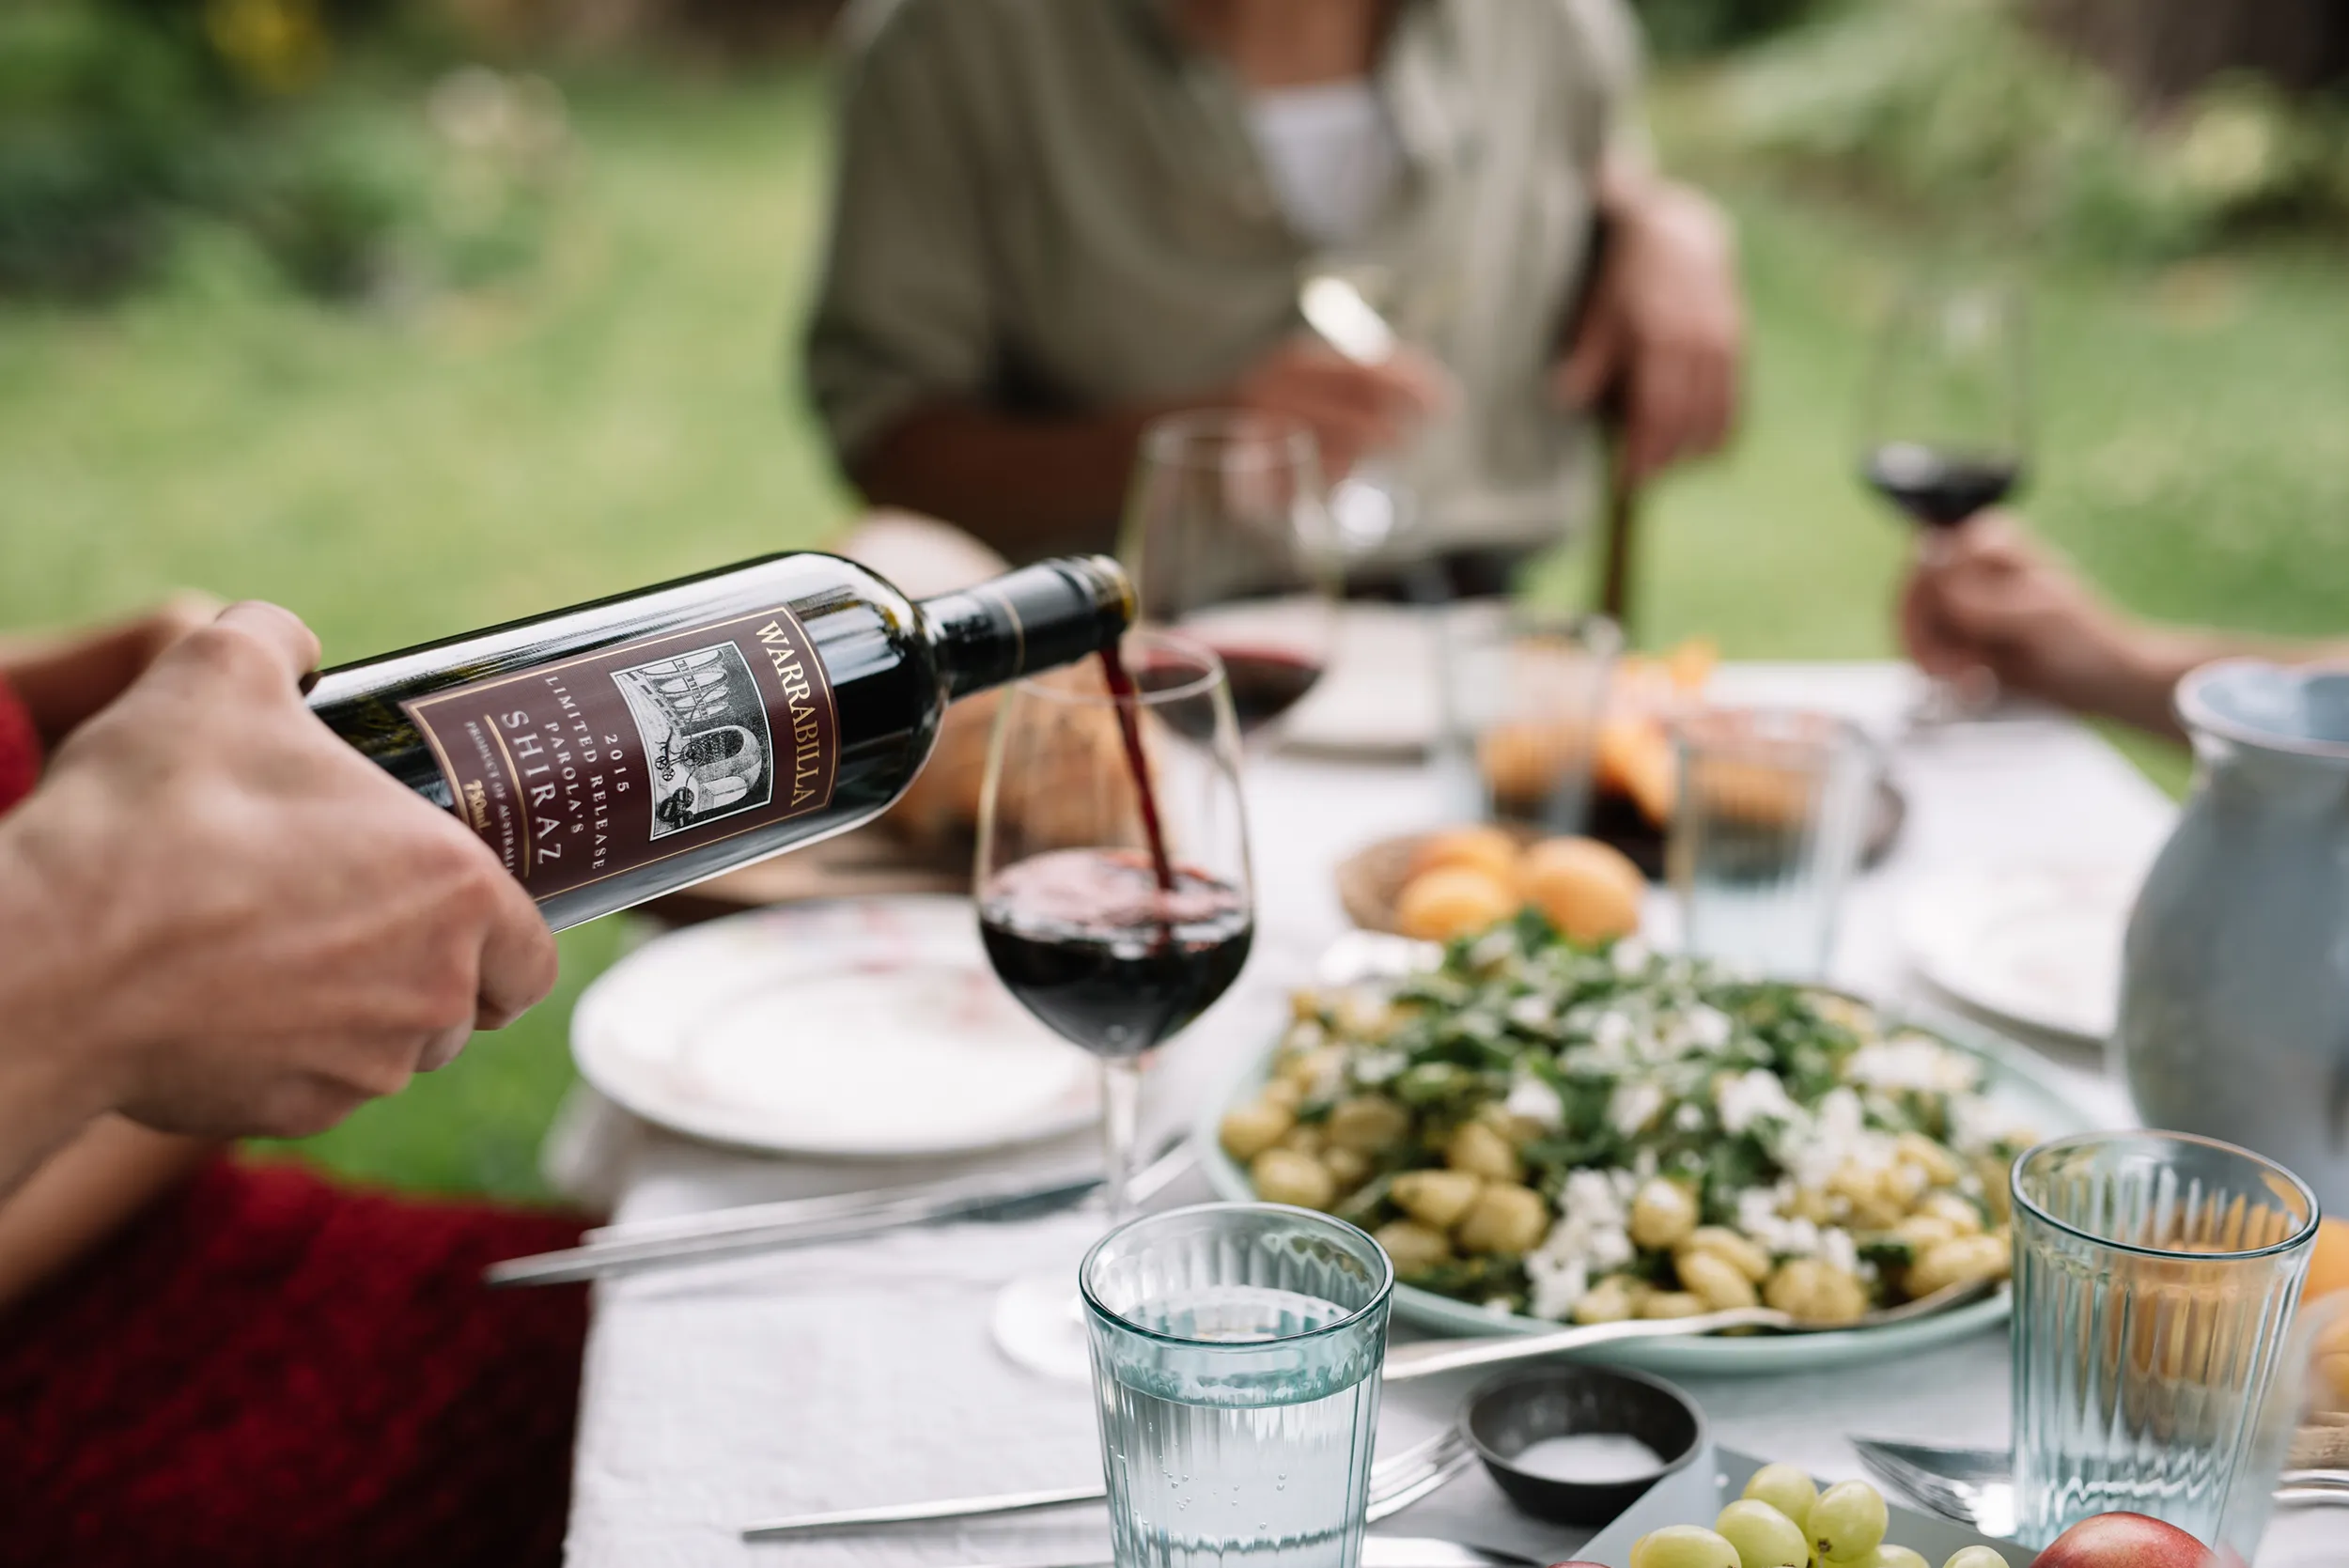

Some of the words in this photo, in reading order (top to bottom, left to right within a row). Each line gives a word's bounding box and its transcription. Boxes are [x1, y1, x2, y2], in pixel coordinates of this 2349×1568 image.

[464, 721, 501, 779] PRODUCT
[491, 782, 507, 800] OF
[544, 722, 584, 834] PAROLA'S
[545, 675, 598, 763] LIMITED
[590, 774, 608, 869] RELEASE
[604, 734, 630, 792] 2015
[756, 620, 820, 807] WARRABILLA
[501, 710, 562, 864] SHIRAZ
